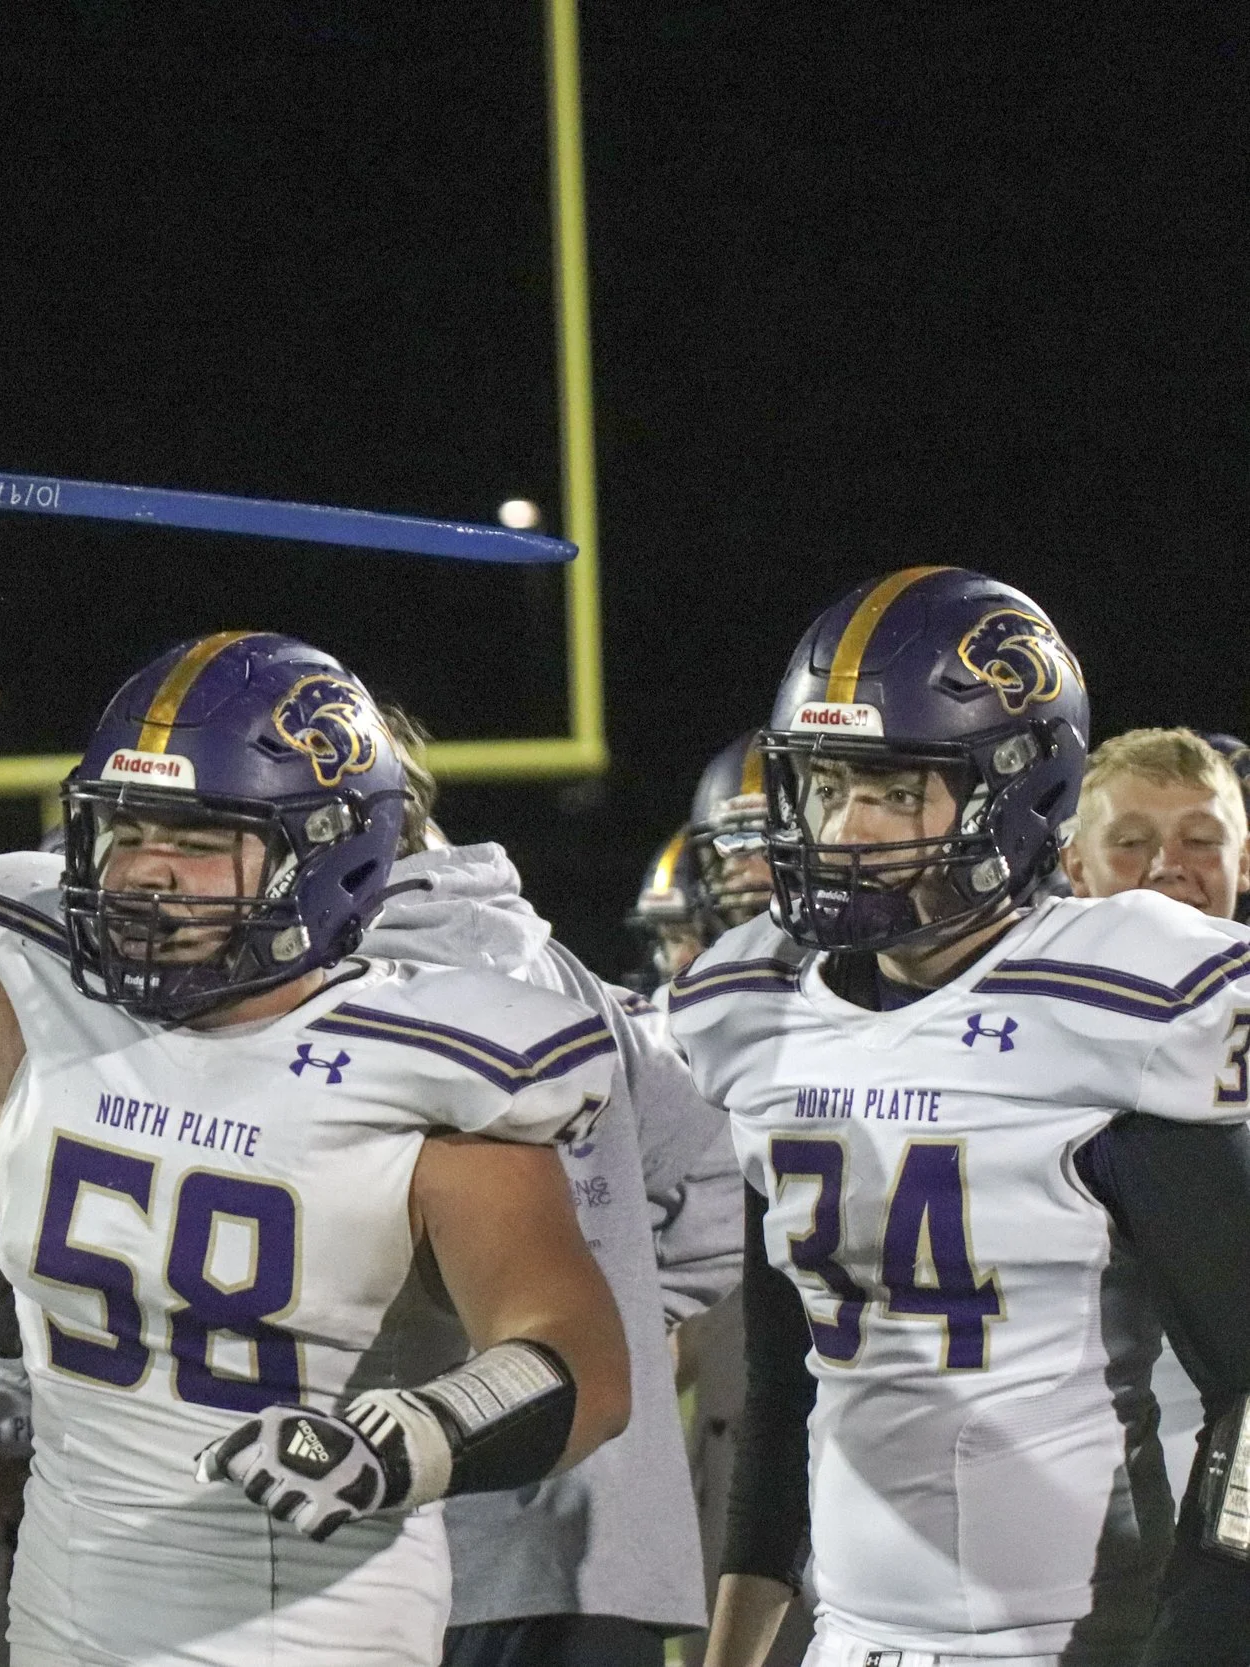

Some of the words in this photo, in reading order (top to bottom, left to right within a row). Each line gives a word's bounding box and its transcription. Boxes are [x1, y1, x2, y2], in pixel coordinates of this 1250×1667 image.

[800, 708, 869, 727] Riddell
[112, 754, 181, 777] Riddell
[124, 973, 160, 987] Riddll
[795, 1087, 854, 1119] NORTH
[864, 1088, 942, 1122] PLATTE
[96, 1093, 170, 1138] NORTH
[178, 1111, 261, 1157] PLATTE
[28, 1126, 307, 1415] 58
[768, 1131, 1007, 1376] 34
[297, 1419, 330, 1462] adidas
